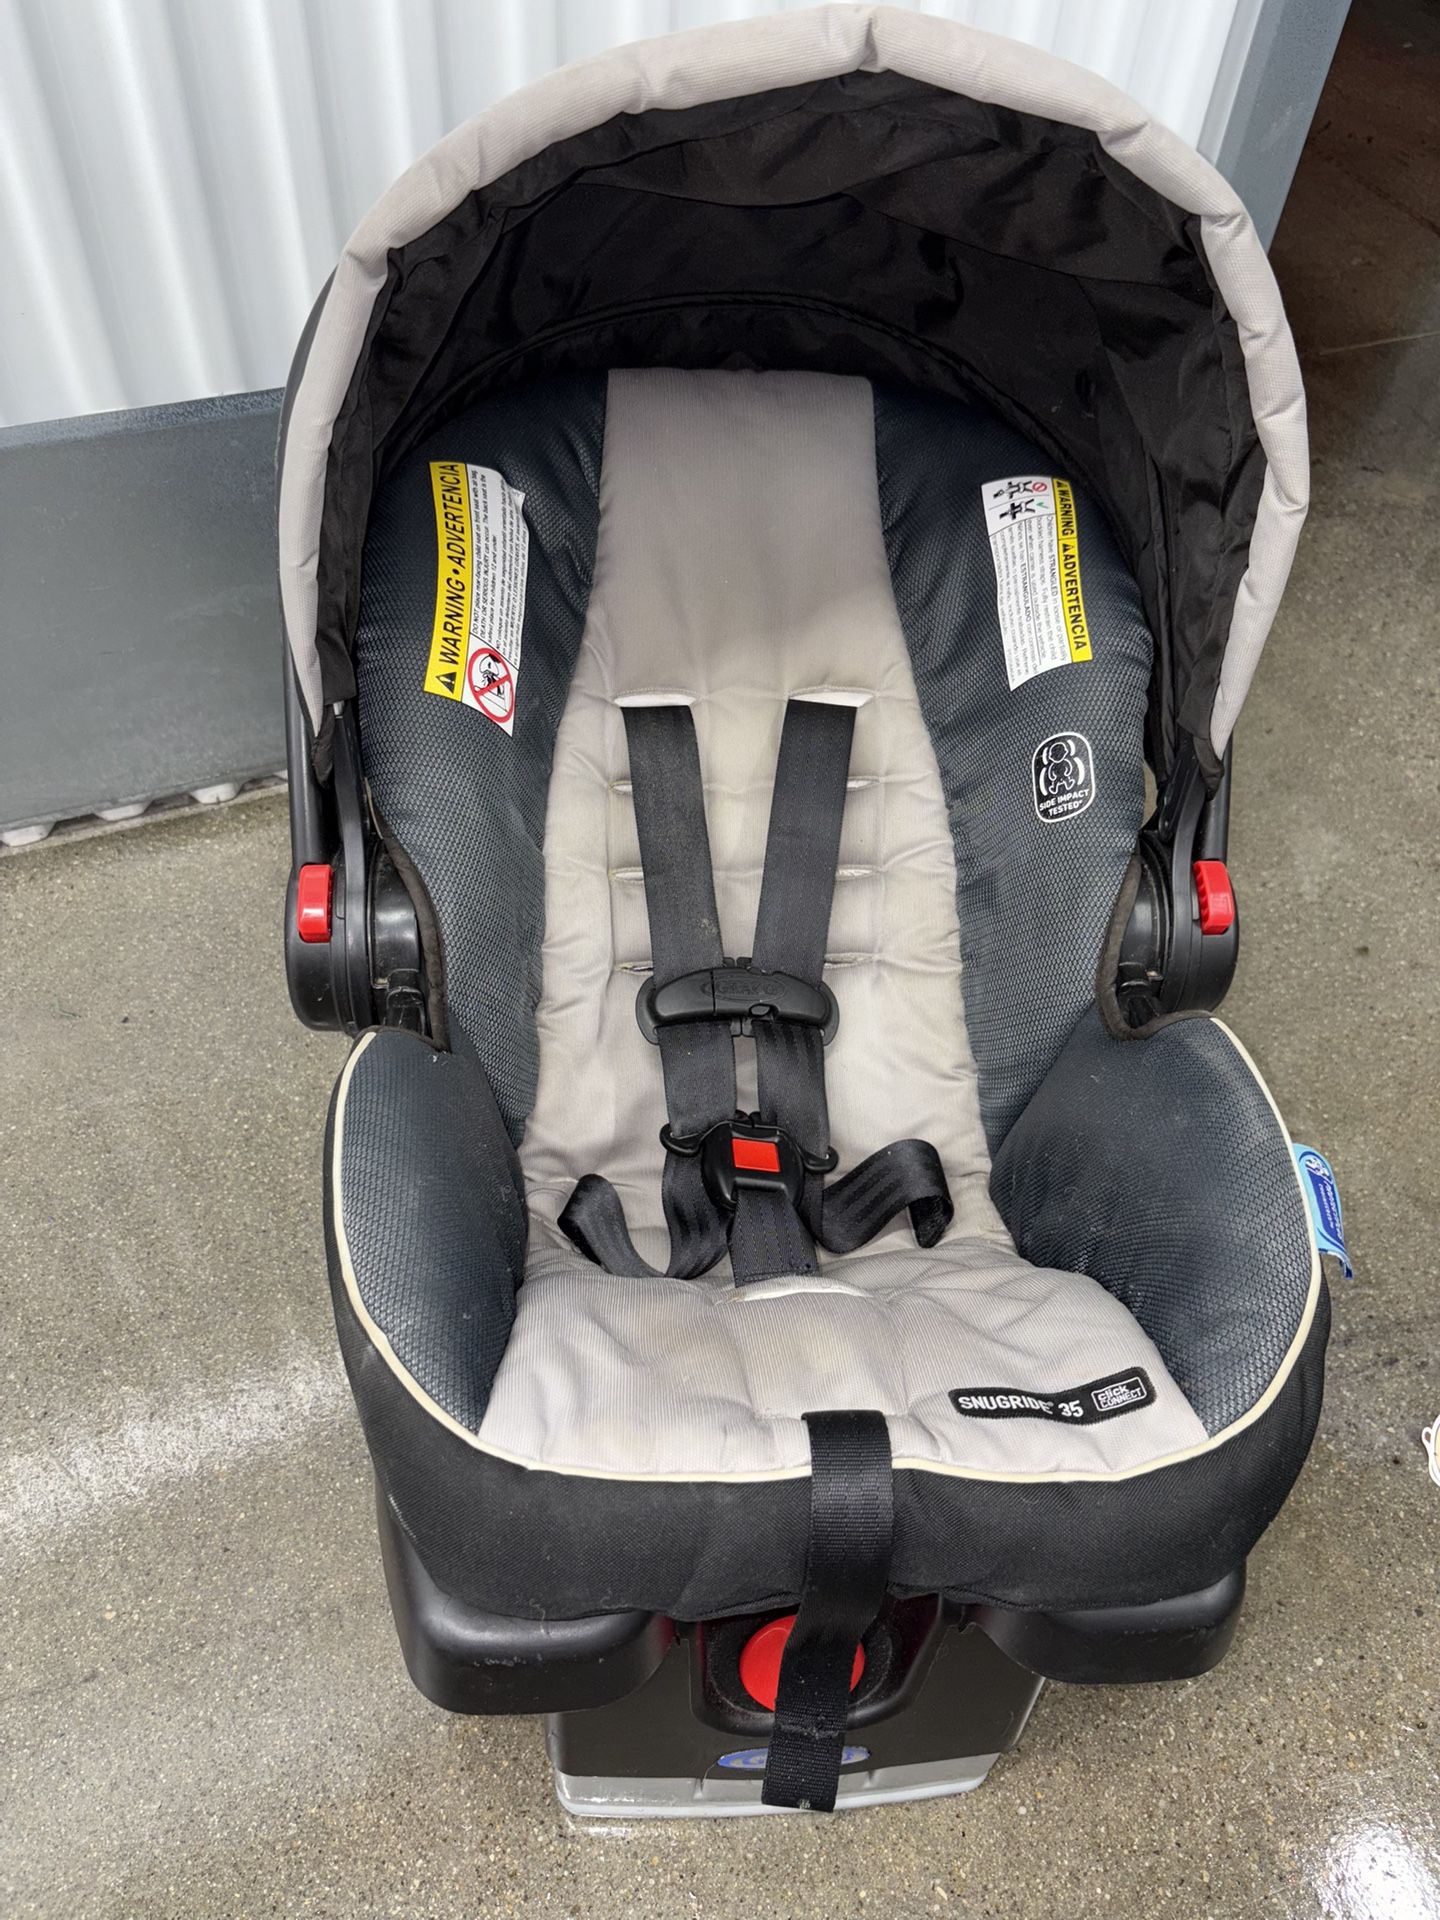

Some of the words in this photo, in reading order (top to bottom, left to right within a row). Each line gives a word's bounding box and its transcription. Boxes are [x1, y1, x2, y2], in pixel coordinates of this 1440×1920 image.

[437, 464, 466, 568] ADVERTENCIA
[1060, 490, 1075, 536] WARNING
[1020, 563, 1032, 622] ESTRANGULADO
[1049, 554, 1058, 596] STRANGLED
[438, 577, 466, 666] WARNING
[1063, 553, 1087, 650] ADVERTENCIA
[1039, 798, 1056, 811] SIDE
[1057, 789, 1090, 802] IMPACT
[1058, 1400, 1084, 1417] 35
[1098, 1384, 1129, 1401] click
[1099, 1389, 1141, 1410] CONNECT
